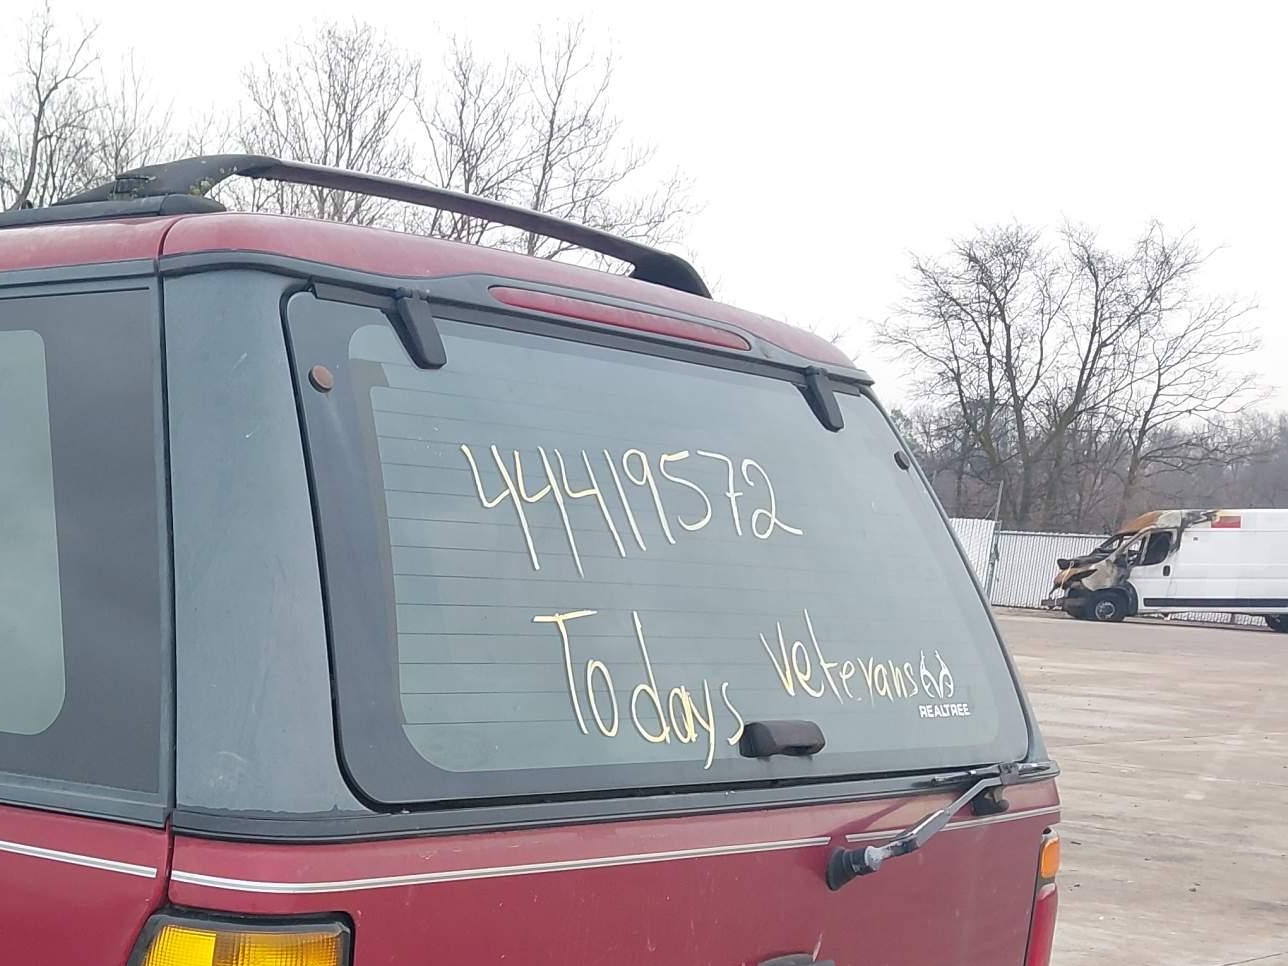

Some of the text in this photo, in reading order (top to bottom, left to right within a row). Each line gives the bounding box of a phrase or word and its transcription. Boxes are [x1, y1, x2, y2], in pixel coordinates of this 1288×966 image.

[461, 444, 804, 578] 44419572
[759, 608, 919, 706] Veterans
[918, 703, 971, 719] REALTREE
